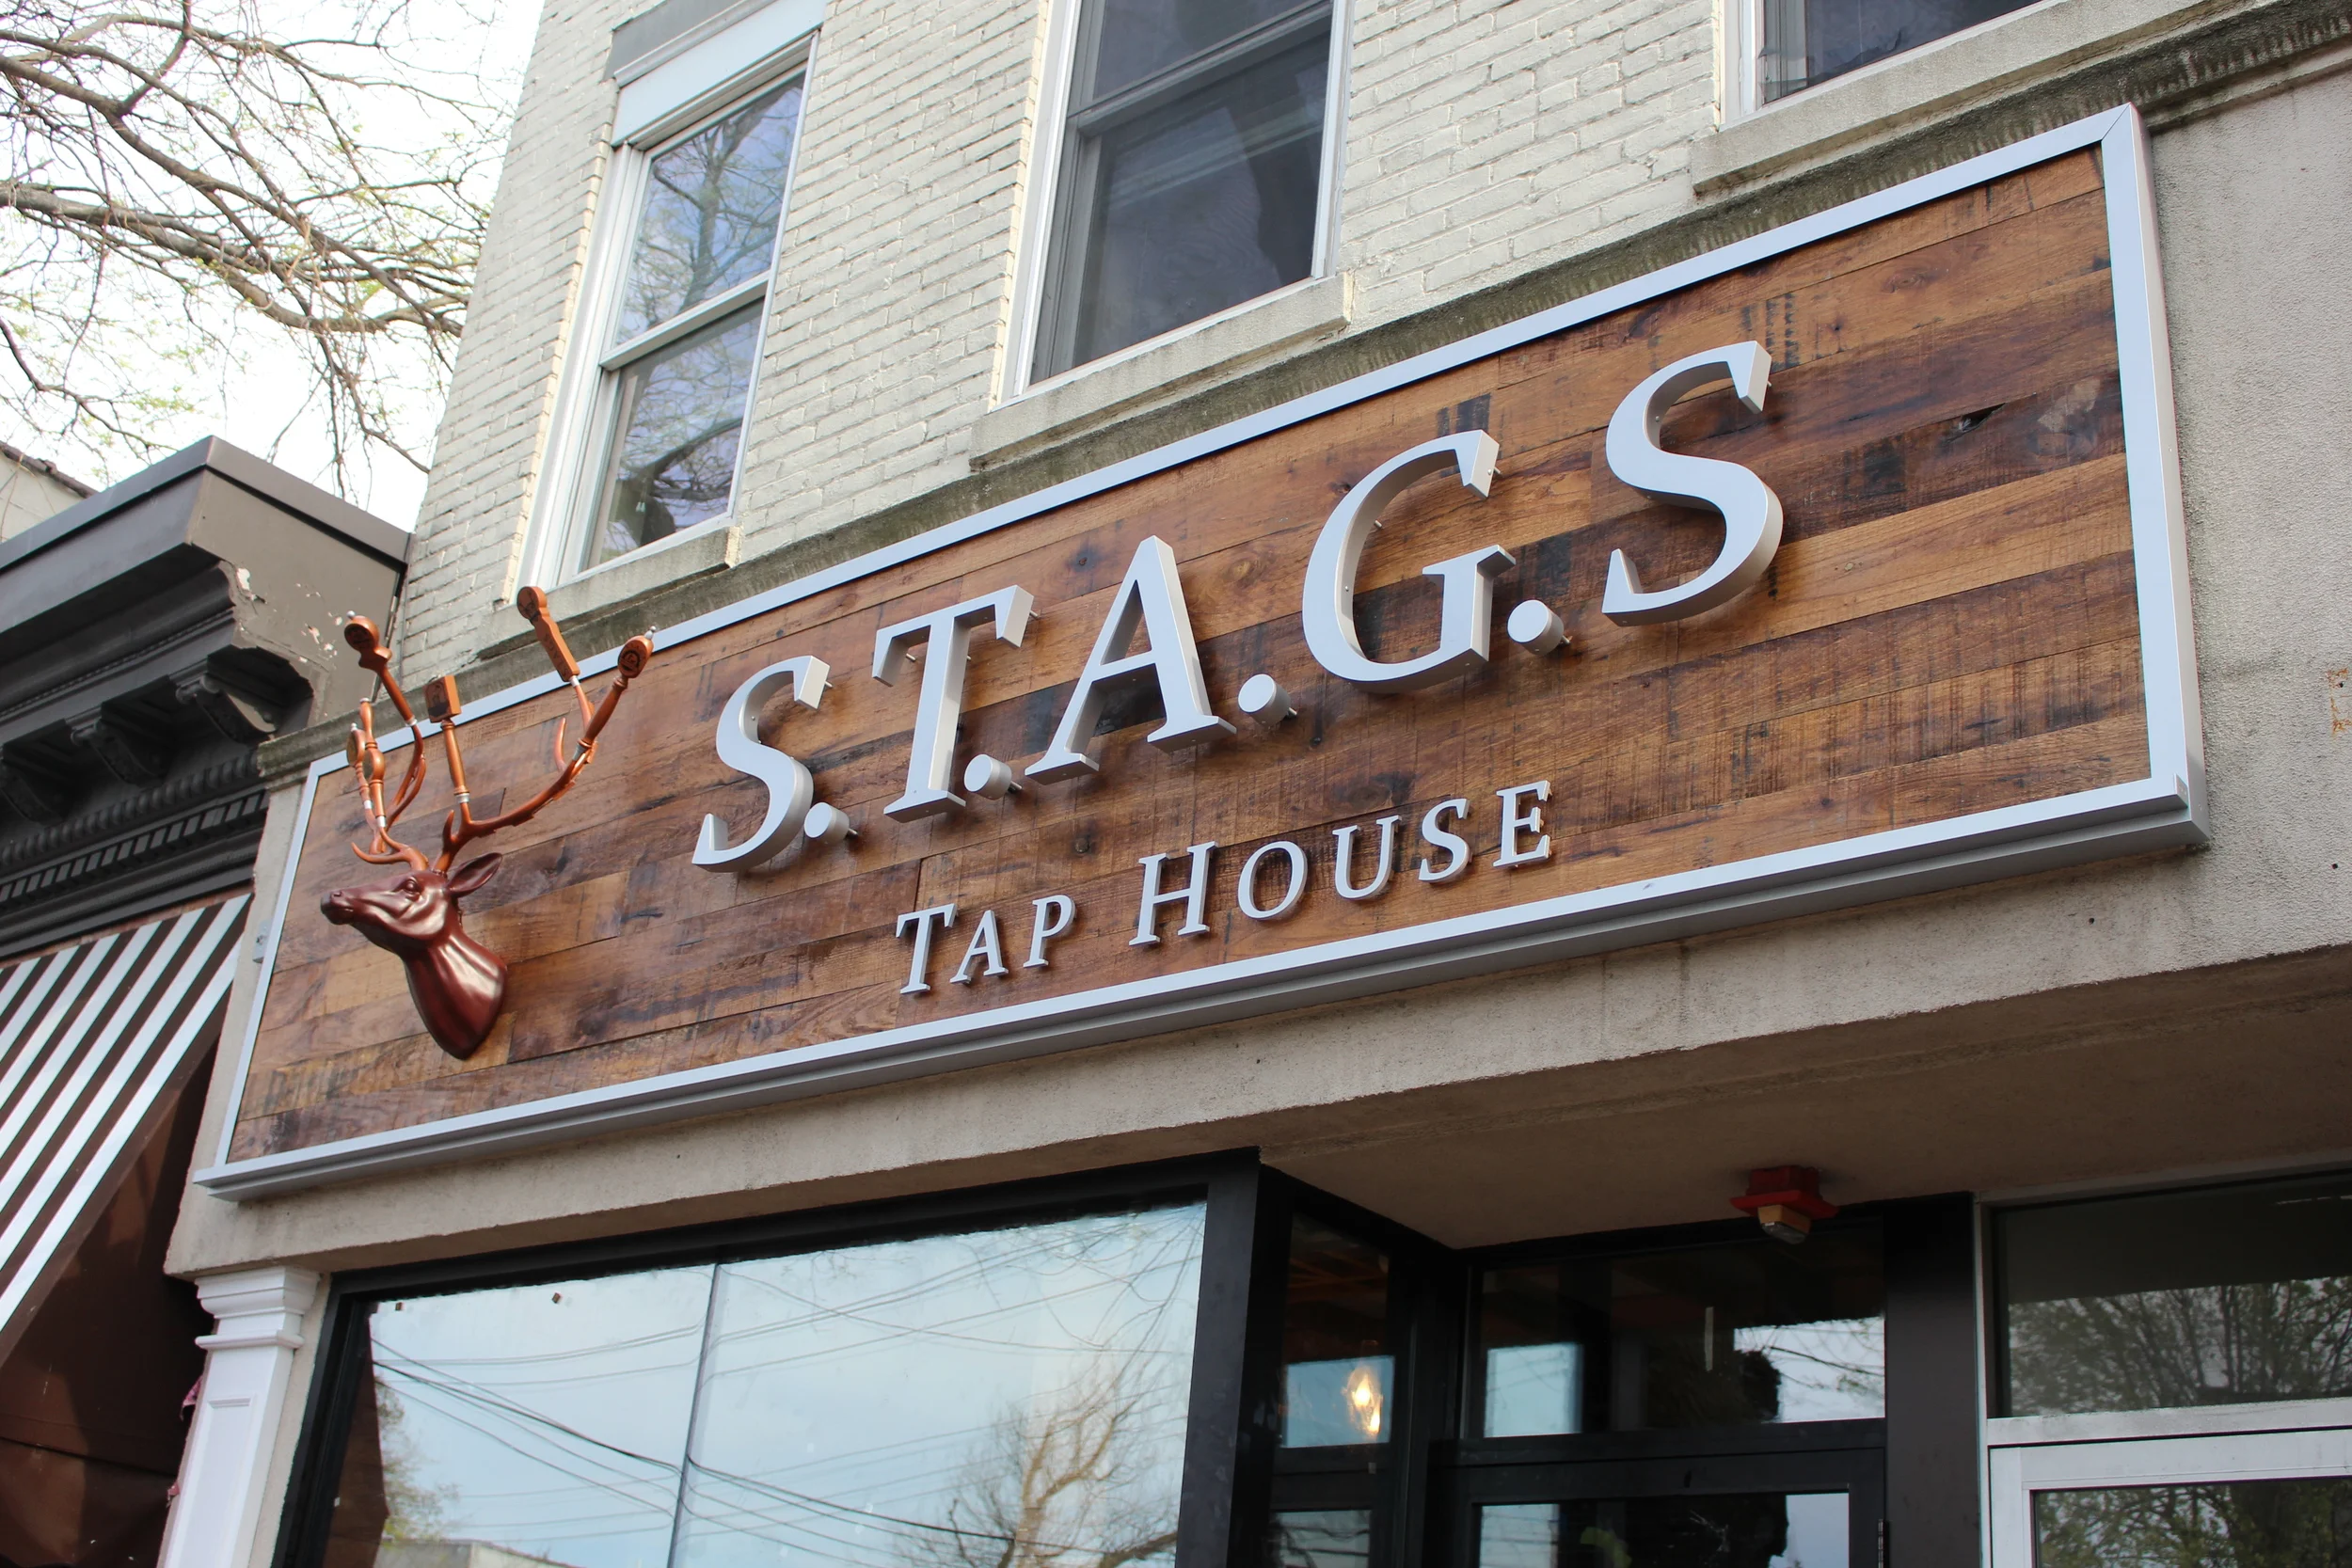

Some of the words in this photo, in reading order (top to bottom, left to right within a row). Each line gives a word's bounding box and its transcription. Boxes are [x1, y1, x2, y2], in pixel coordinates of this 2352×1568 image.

[691, 341, 1783, 873] S.T.A.G.S
[895, 895, 1076, 995] TAP
[1129, 780, 1552, 947] HOUSE
